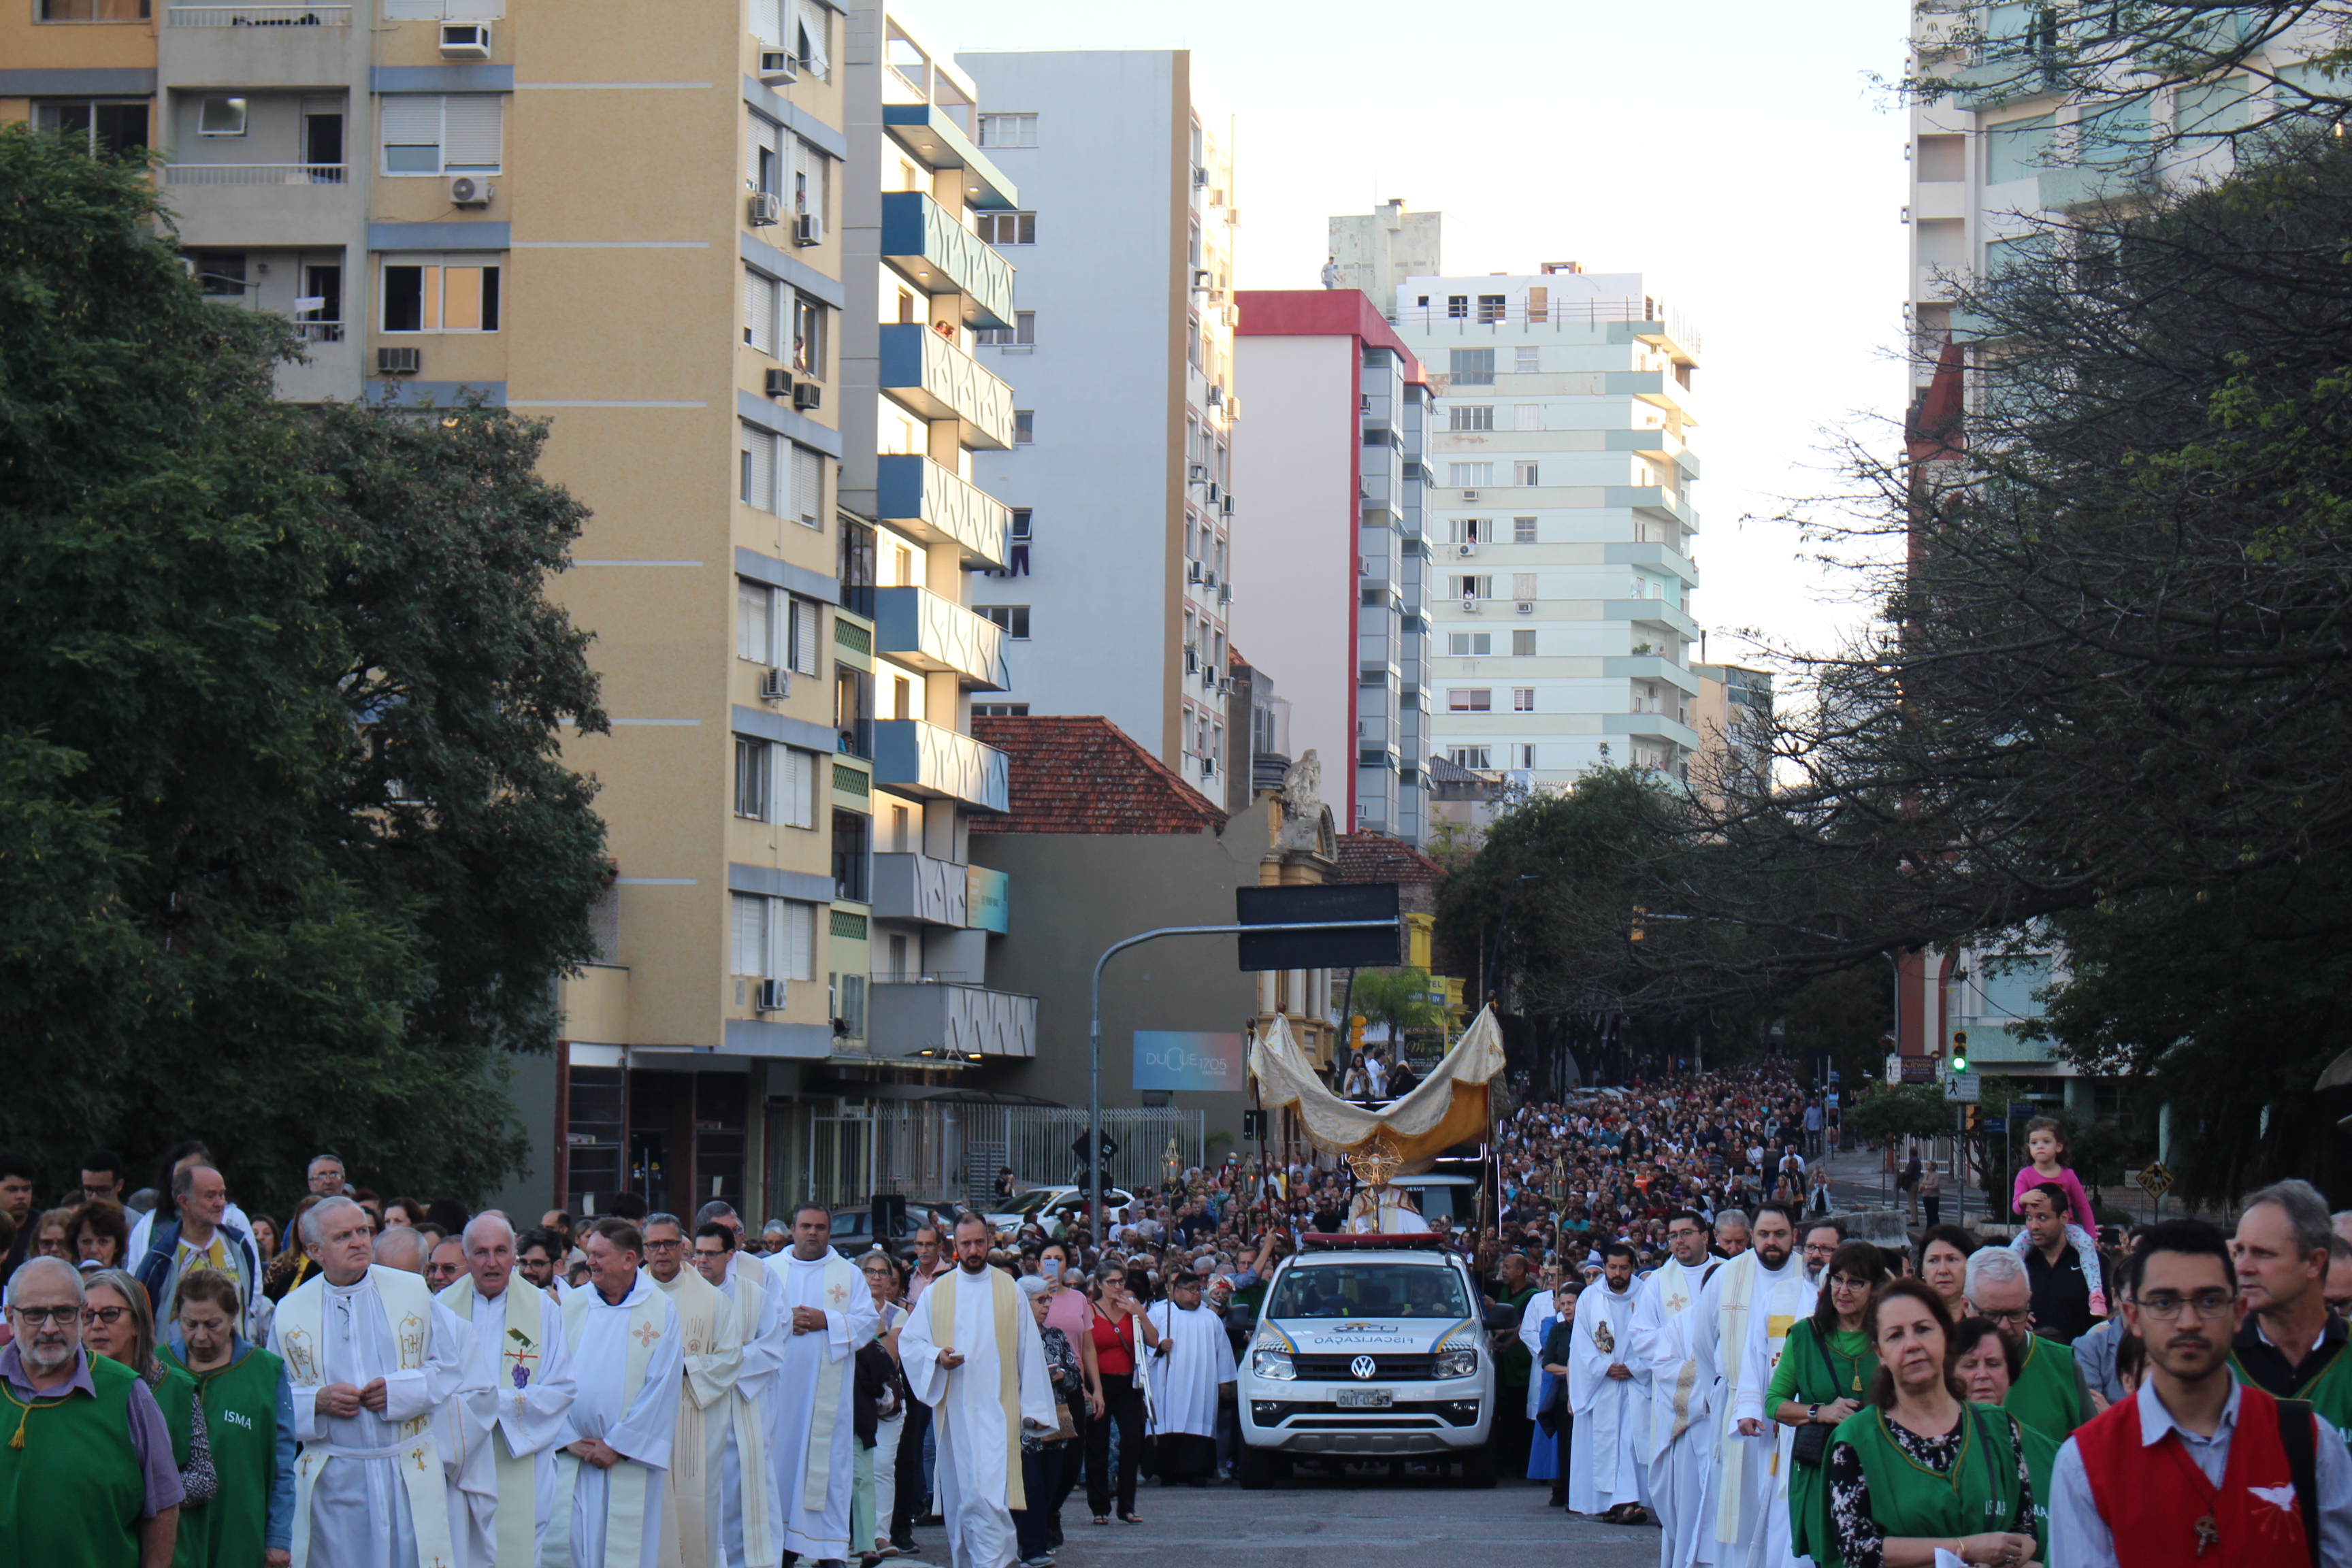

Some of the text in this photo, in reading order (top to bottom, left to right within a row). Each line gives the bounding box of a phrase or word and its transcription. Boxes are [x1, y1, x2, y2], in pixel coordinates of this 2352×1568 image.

[1146, 1047, 1227, 1072] DUQUE 1705
[224, 1409, 252, 1430] ISMA
